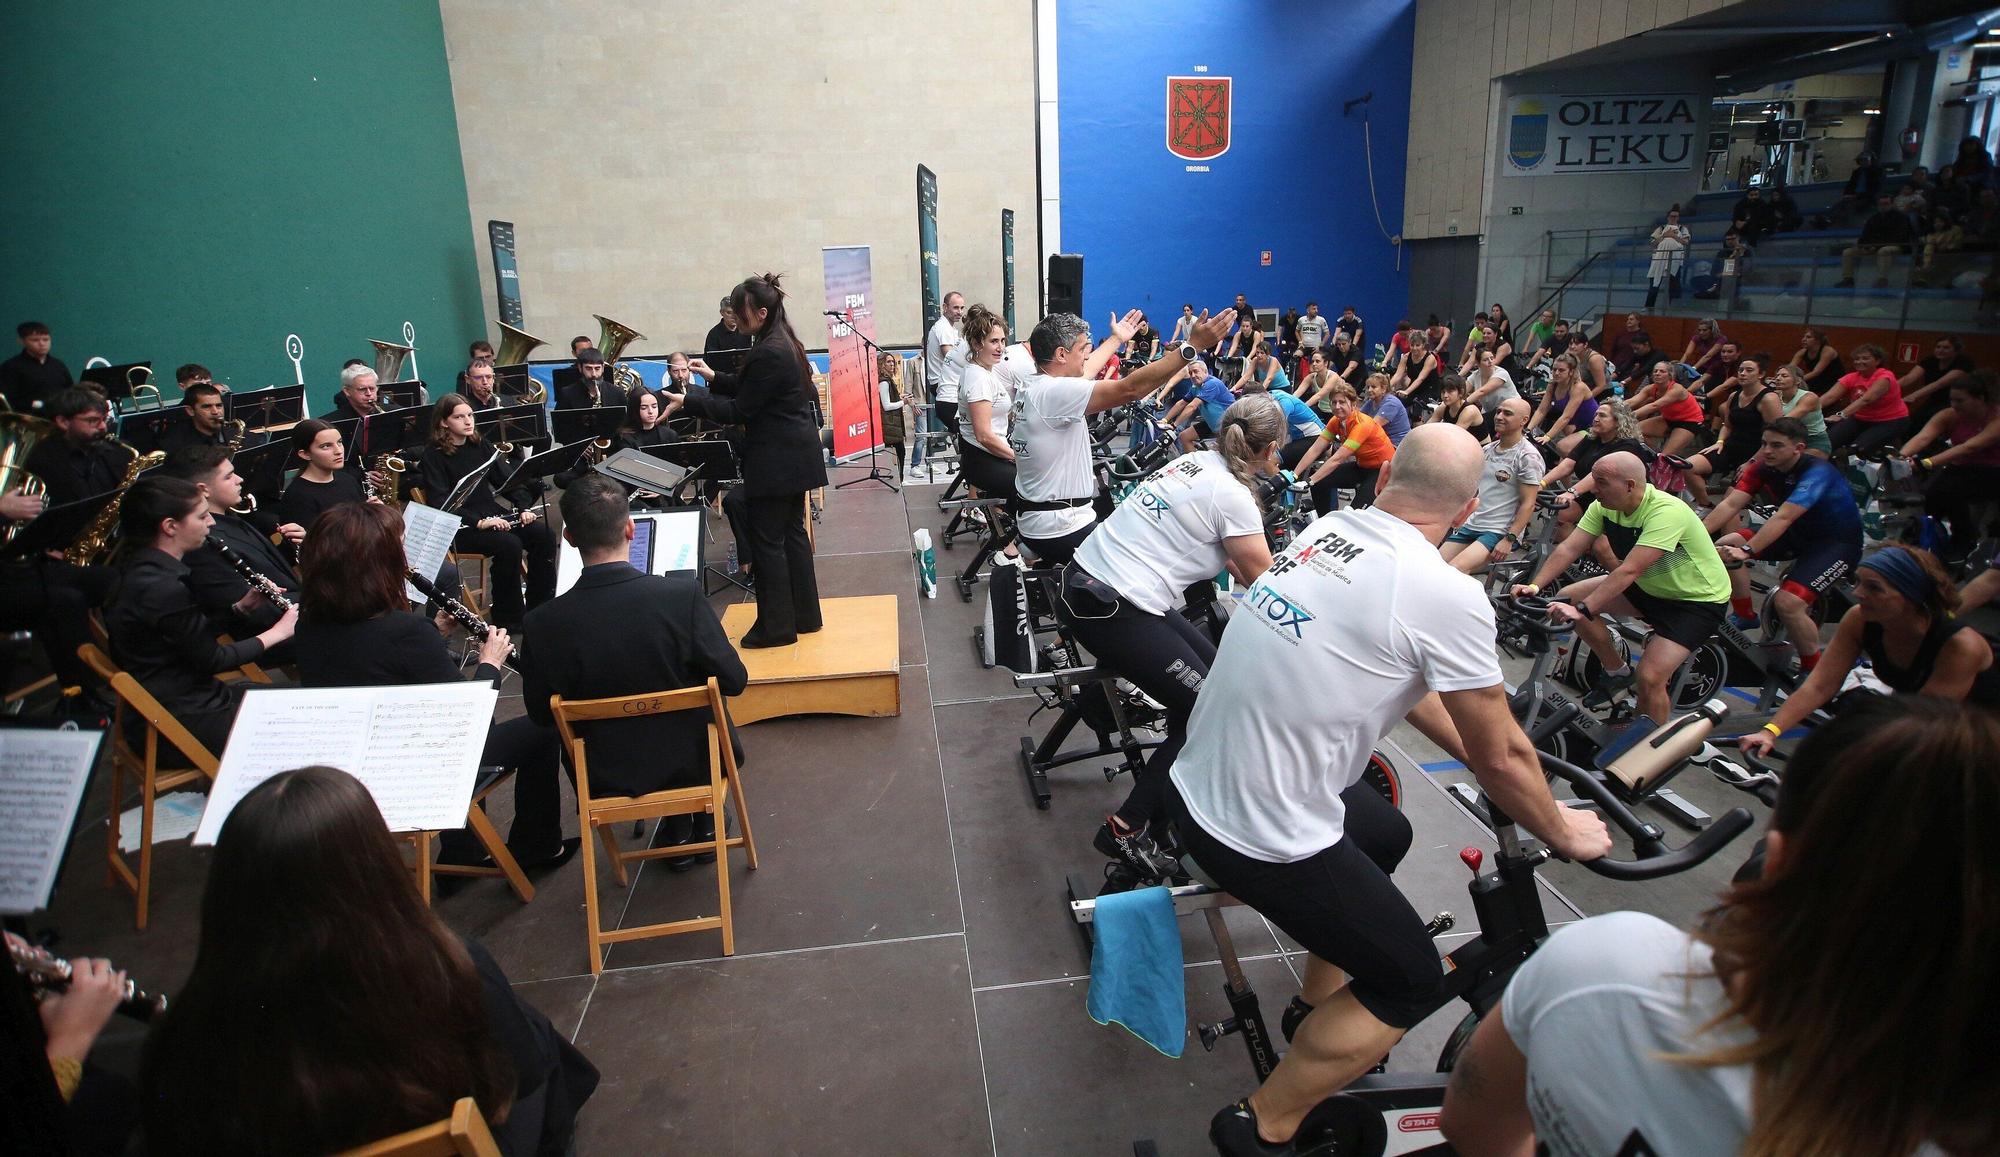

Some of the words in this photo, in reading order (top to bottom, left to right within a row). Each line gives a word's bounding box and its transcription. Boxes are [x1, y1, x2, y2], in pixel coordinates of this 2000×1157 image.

[1558, 99, 1696, 126] OLTZA
[1555, 133, 1695, 166] LEKU
[845, 293, 865, 309] FBM
[291, 343, 298, 353] 2
[1175, 460, 1203, 478] FBM
[1313, 532, 1365, 564] FBM
[1268, 554, 1298, 577] BF
[1816, 563, 1849, 593] MILAGRO
[1810, 574, 1825, 588] CLUB
[1249, 581, 1313, 640] NTOX
[1245, 1018, 1271, 1075] STUDIO
[1401, 1118, 1436, 1128] STAR
